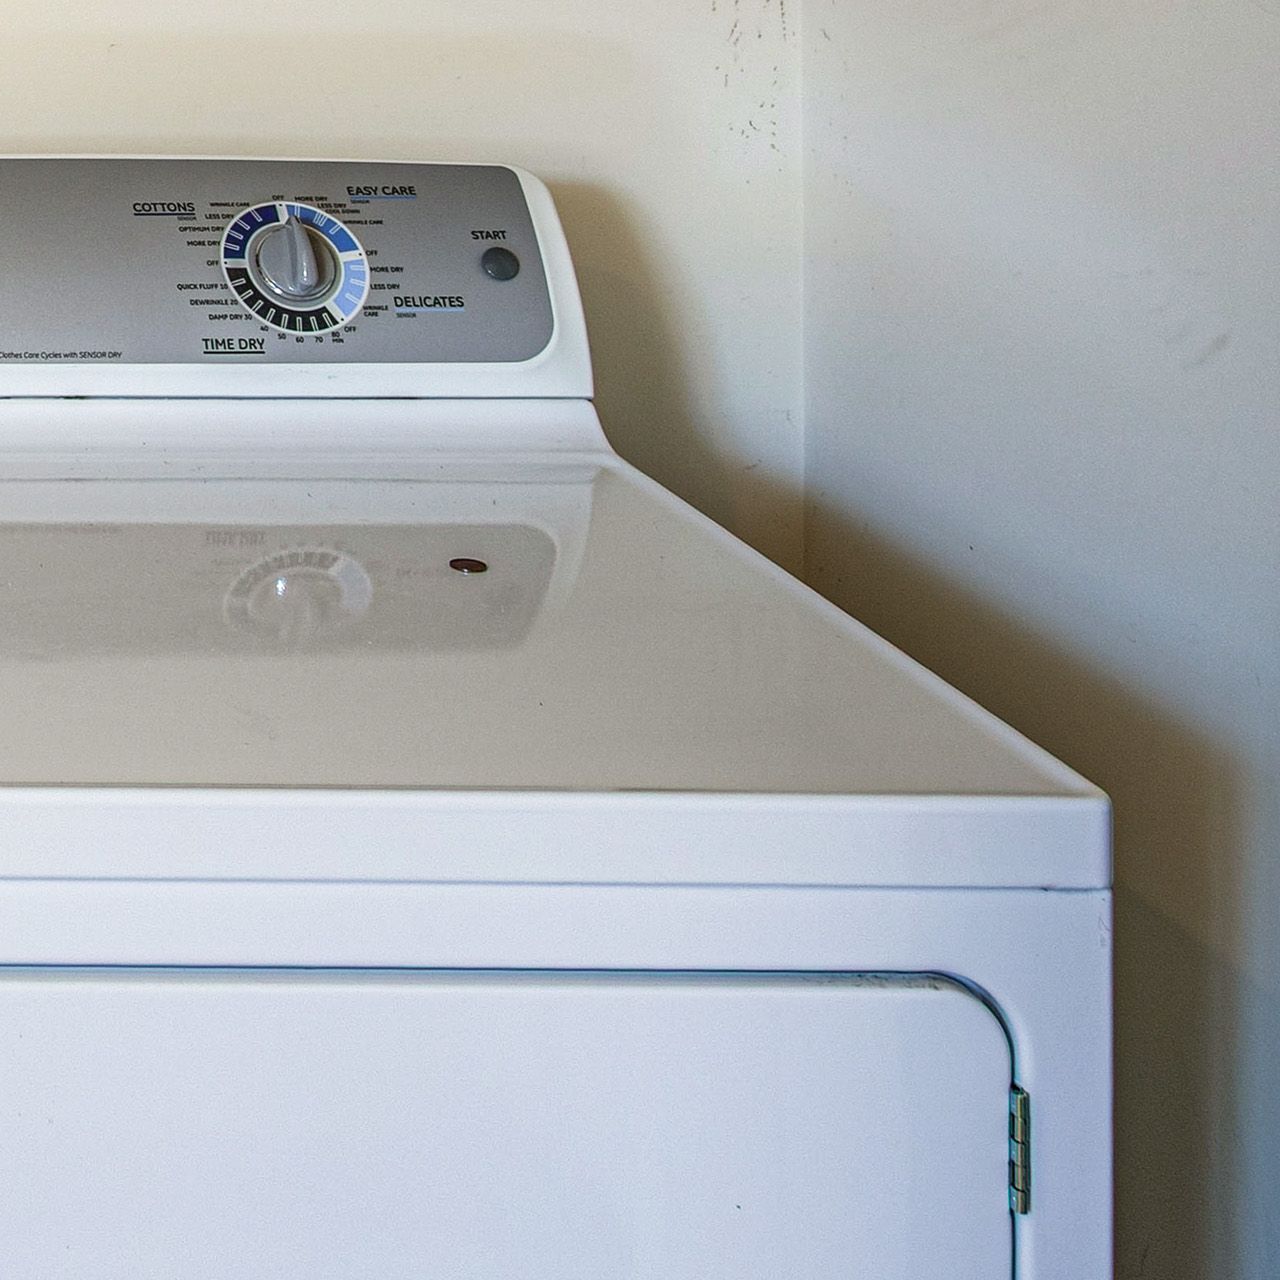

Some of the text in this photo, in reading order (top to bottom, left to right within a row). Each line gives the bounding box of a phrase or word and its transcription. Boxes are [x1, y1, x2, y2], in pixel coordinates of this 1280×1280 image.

[346, 186, 417, 196] EASY CARE
[132, 202, 195, 213] COTTONS
[470, 230, 507, 240] START
[177, 283, 199, 291] QUICK
[199, 283, 218, 291] FLUFF
[393, 296, 465, 308] DELICATES
[202, 338, 265, 350] TIME DRY
[23, 351, 40, 359] Care
[40, 351, 62, 360] Cycles
[63, 351, 78, 359] with
[79, 351, 106, 359] SENSOR
[107, 351, 122, 359] DRY
